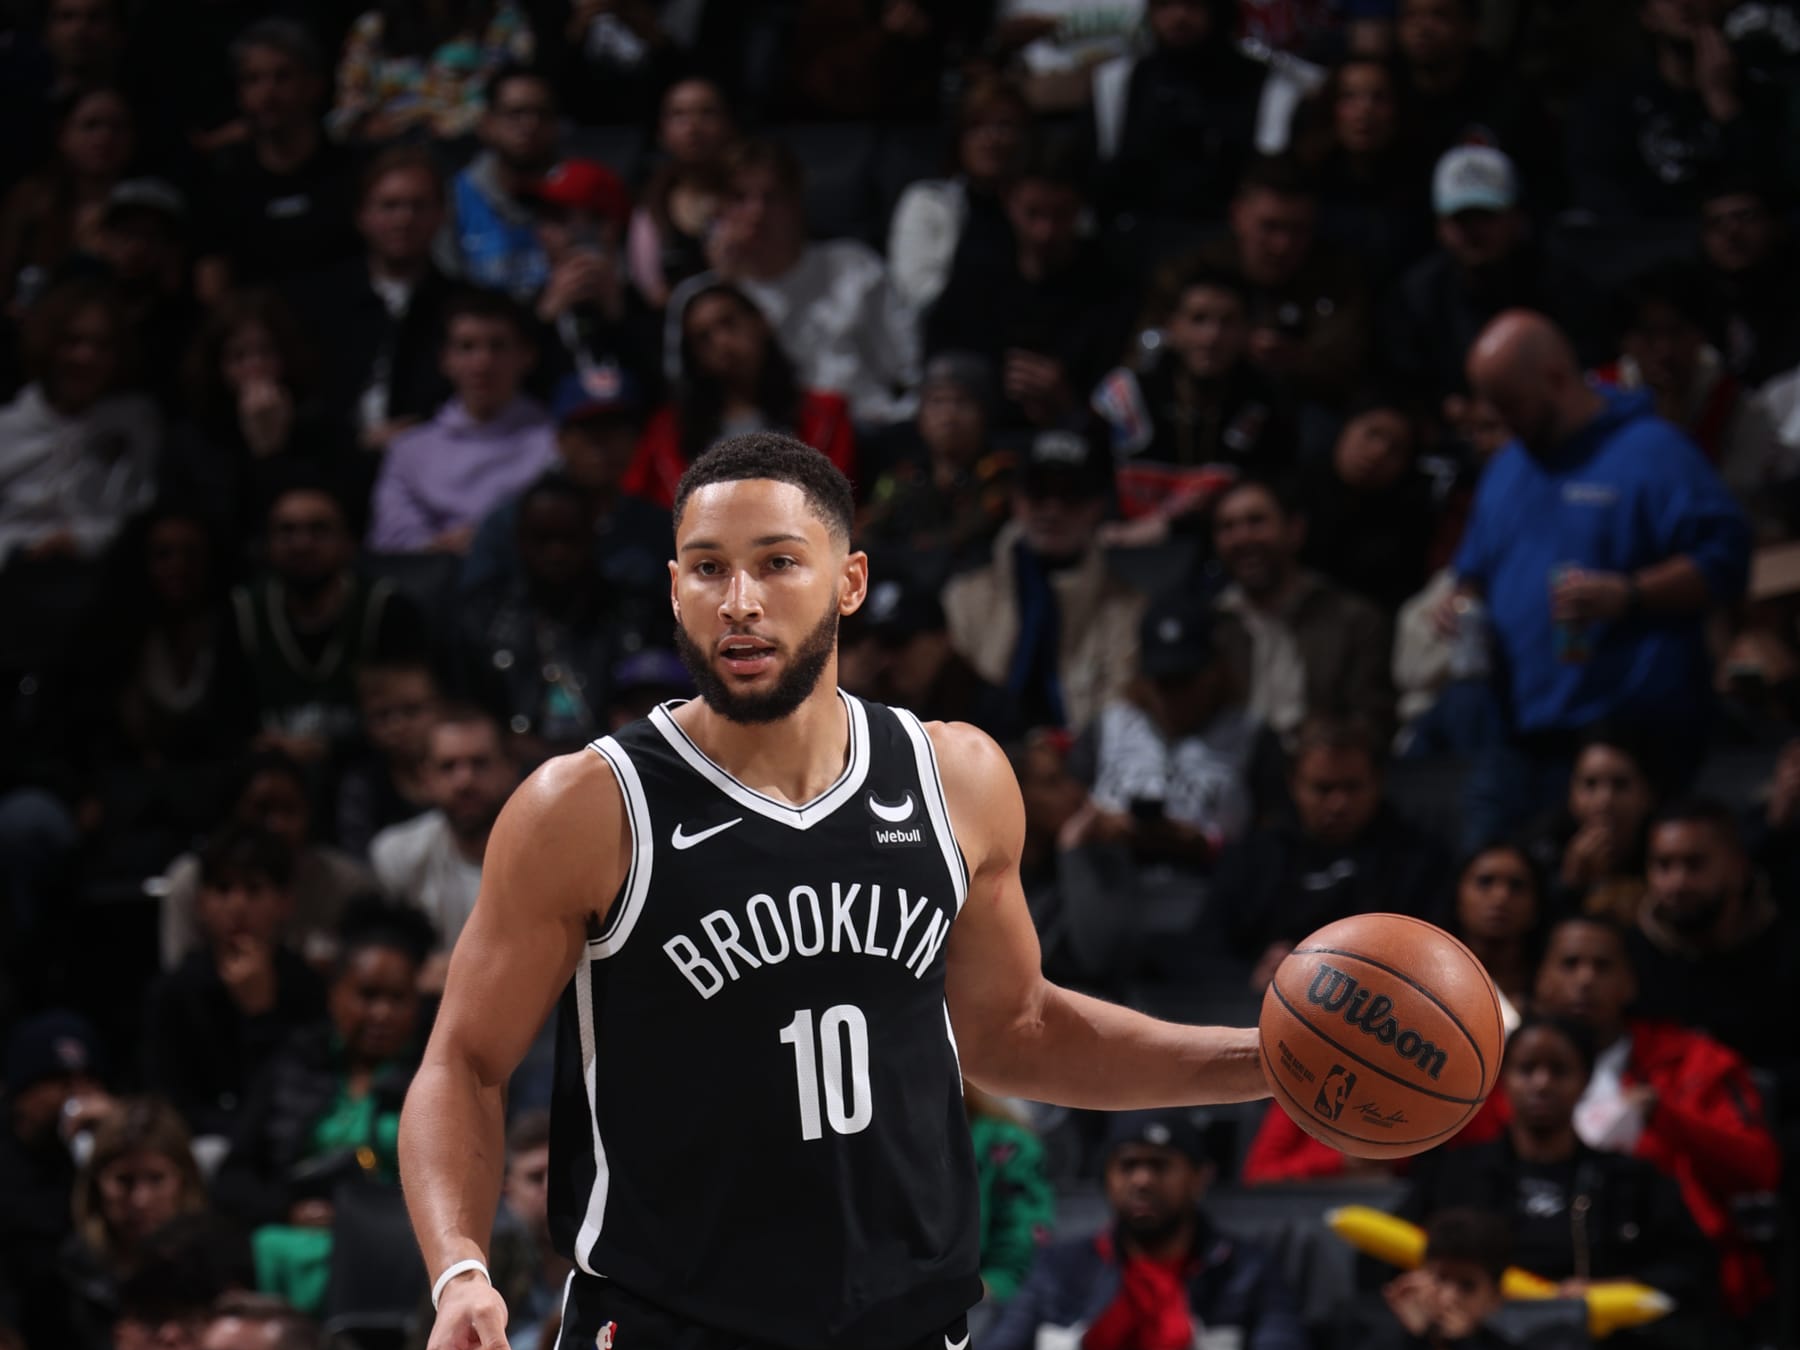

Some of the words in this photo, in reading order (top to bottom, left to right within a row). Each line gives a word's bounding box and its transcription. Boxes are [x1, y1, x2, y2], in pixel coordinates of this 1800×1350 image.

[876, 829, 921, 844] Webull
[662, 882, 951, 1000] BROOKLYN
[779, 1004, 873, 1141] 10
[1307, 963, 1447, 1081] Wilson
